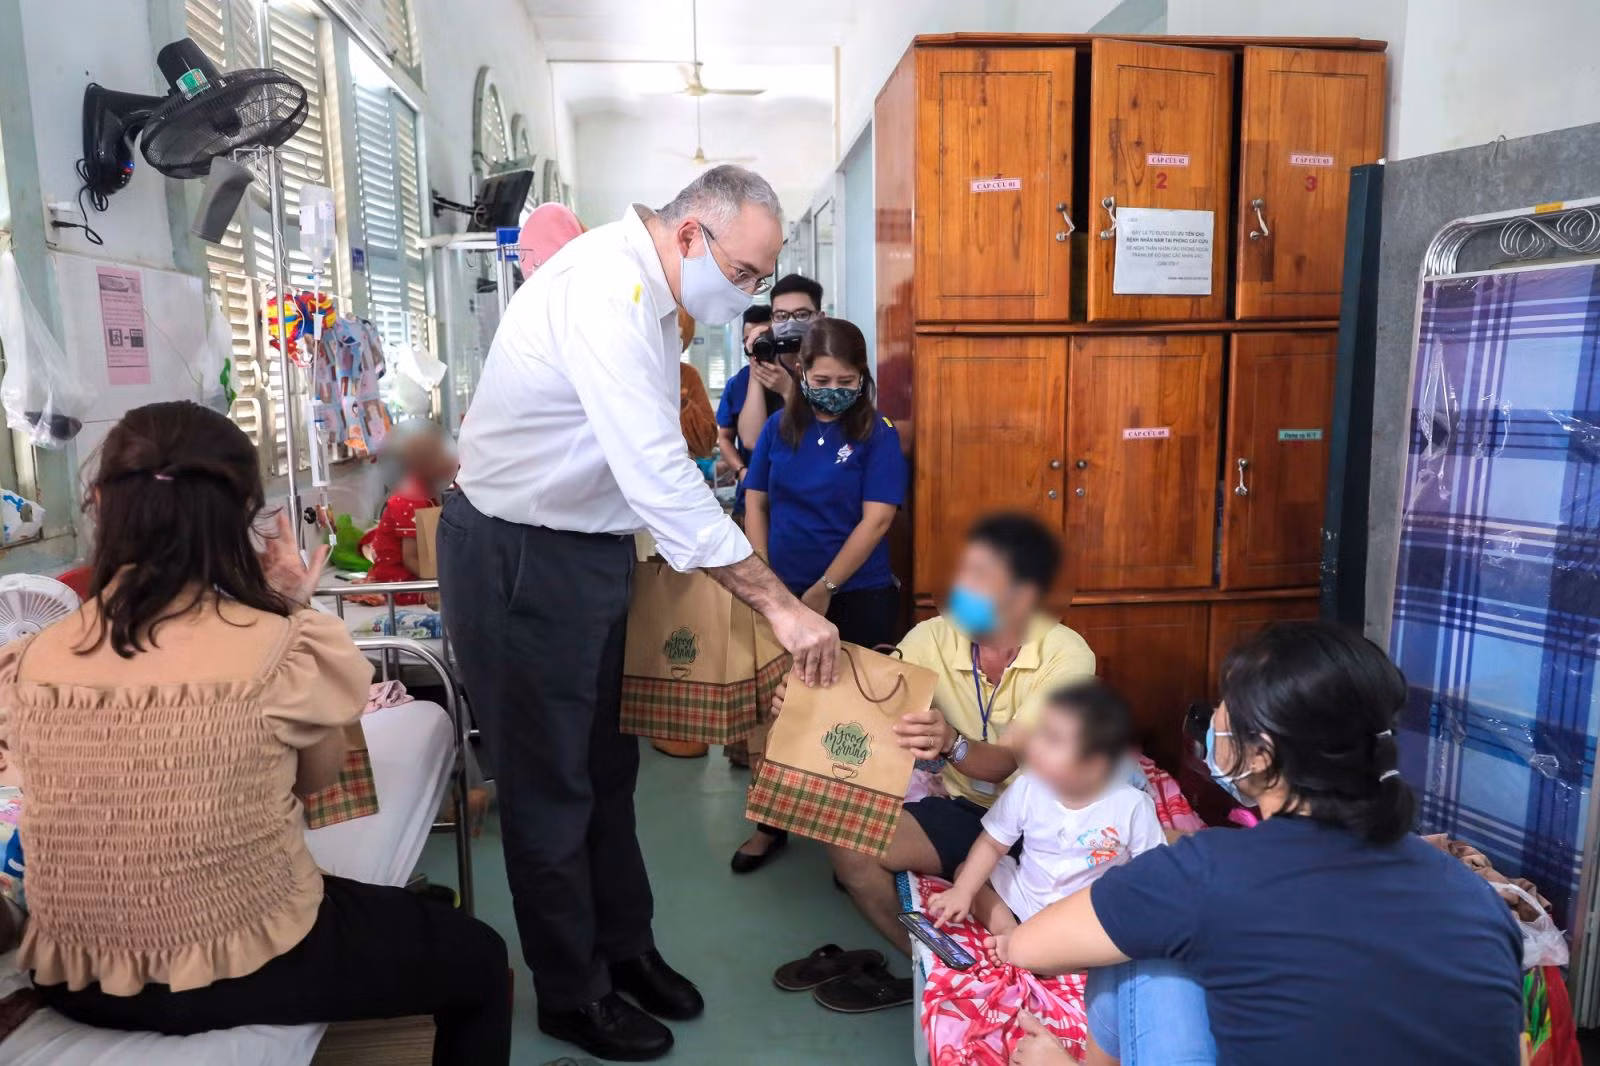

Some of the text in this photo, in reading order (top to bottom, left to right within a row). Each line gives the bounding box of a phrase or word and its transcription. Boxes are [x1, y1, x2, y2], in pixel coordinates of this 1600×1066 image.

[1156, 171, 1168, 190] 2
[1305, 175, 1318, 192] 3
[834, 722, 869, 749] Good
[824, 731, 867, 765] Morning
